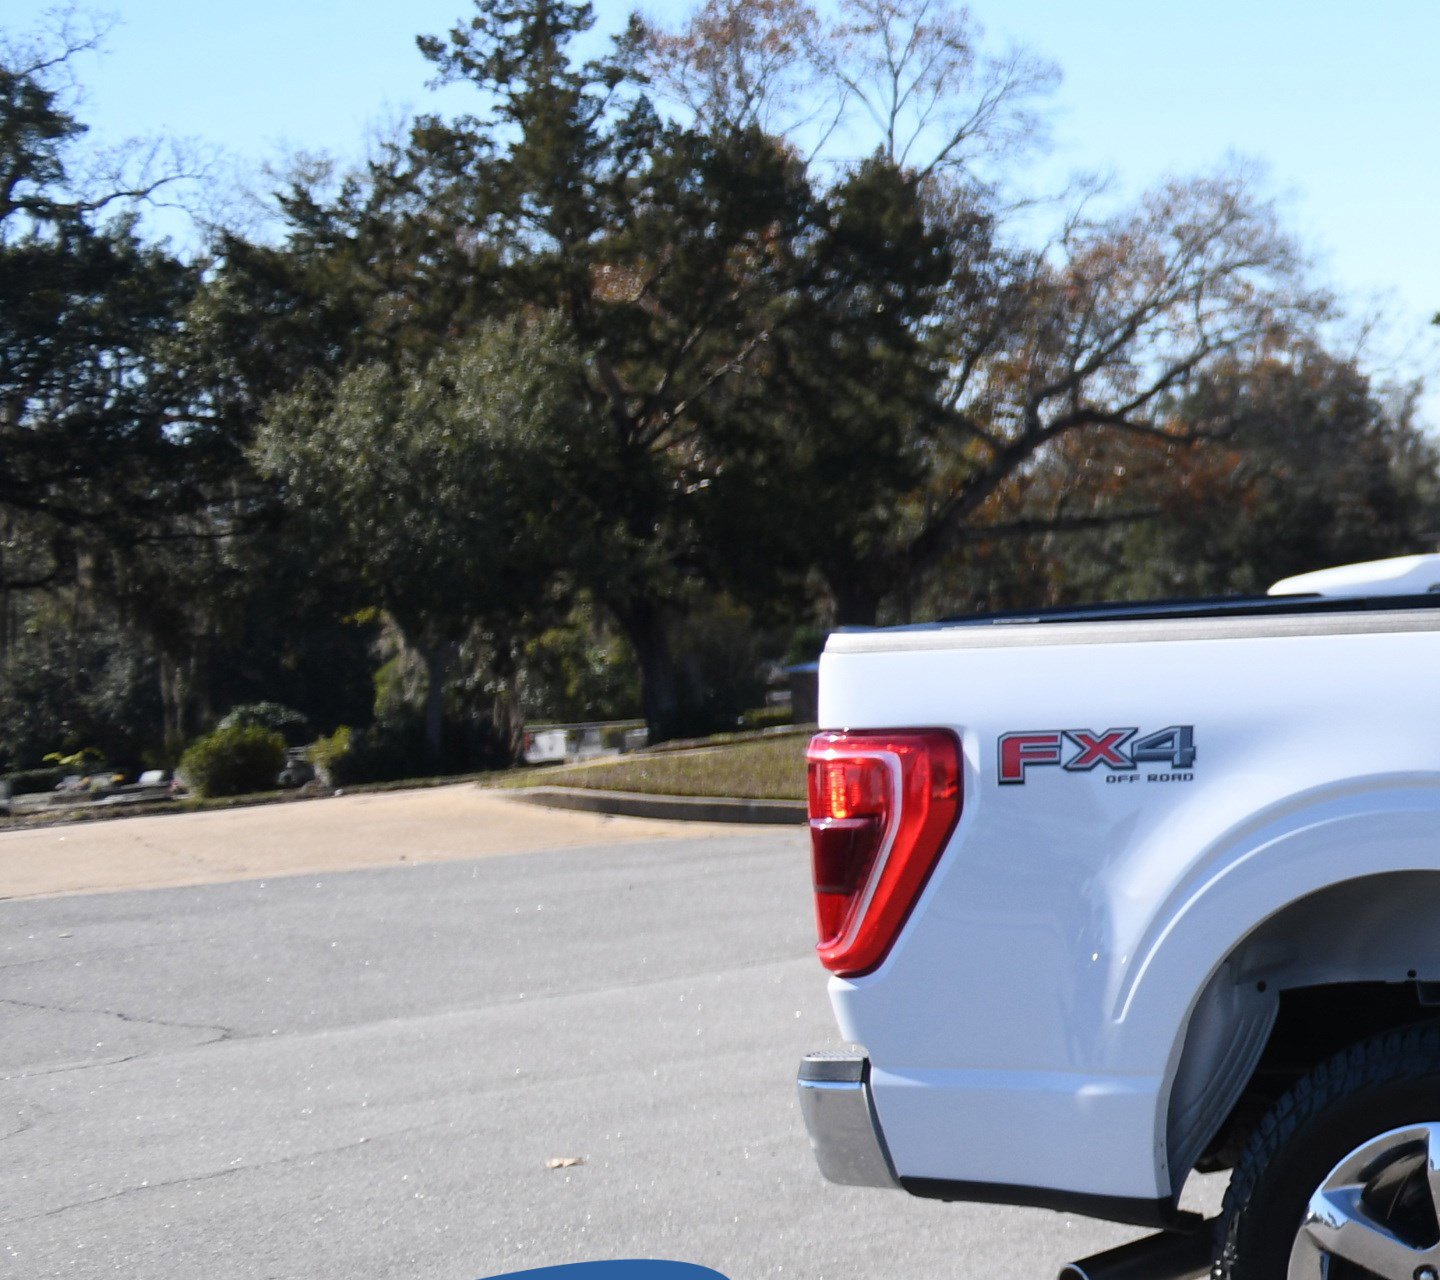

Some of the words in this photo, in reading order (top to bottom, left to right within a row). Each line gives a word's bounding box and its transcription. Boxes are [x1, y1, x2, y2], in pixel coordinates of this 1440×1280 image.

[998, 725, 1196, 785] FX4
[1106, 773, 1140, 784] OFF
[1147, 772, 1194, 782] ROAD
